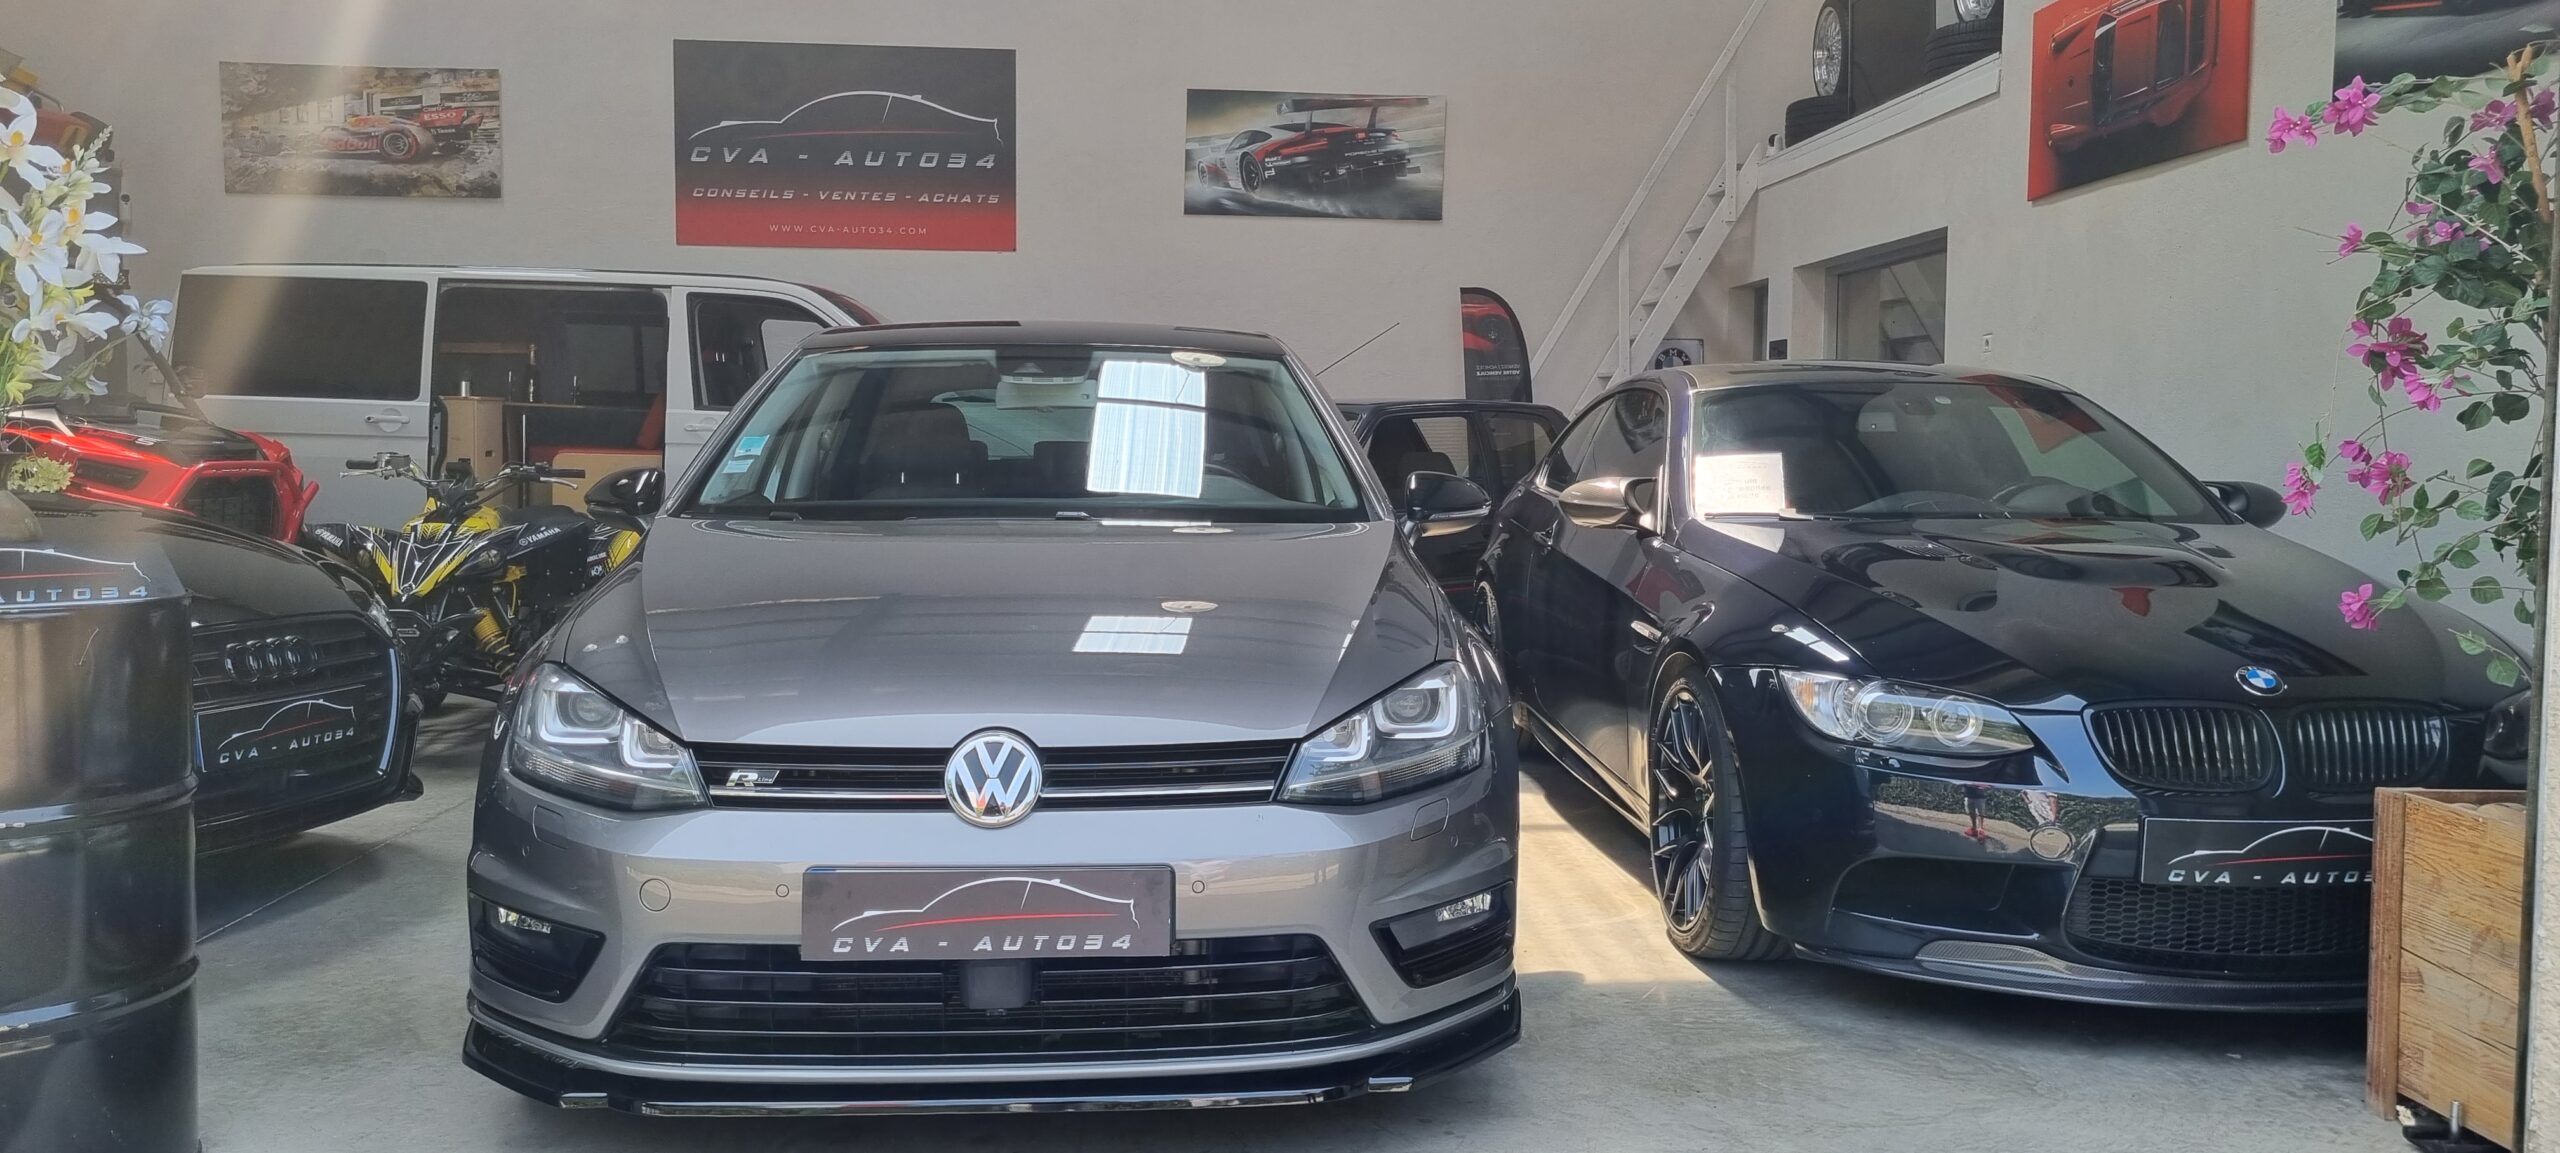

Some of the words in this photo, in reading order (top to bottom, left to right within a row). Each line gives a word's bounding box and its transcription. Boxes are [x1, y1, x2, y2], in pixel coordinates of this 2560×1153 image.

[423, 112, 456, 120] ESSO
[690, 146, 769, 164] CVA
[834, 150, 997, 169] AUTO34
[692, 187, 795, 199] CONSEILS
[818, 190, 897, 202] VENTES
[918, 193, 1000, 204] ACHATS
[769, 224, 927, 235] WWW.CVA-AUTO34.COM
[1658, 349, 1689, 362] BMW
[526, 527, 562, 543] YAMAHA
[0, 586, 148, 603] UTO34
[219, 746, 259, 764] CVA
[289, 726, 355, 750] AUTO34
[726, 772, 758, 787] R
[2167, 869, 2231, 884] CVA
[832, 936, 910, 953] CVA
[972, 934, 1132, 952] AUTO34
